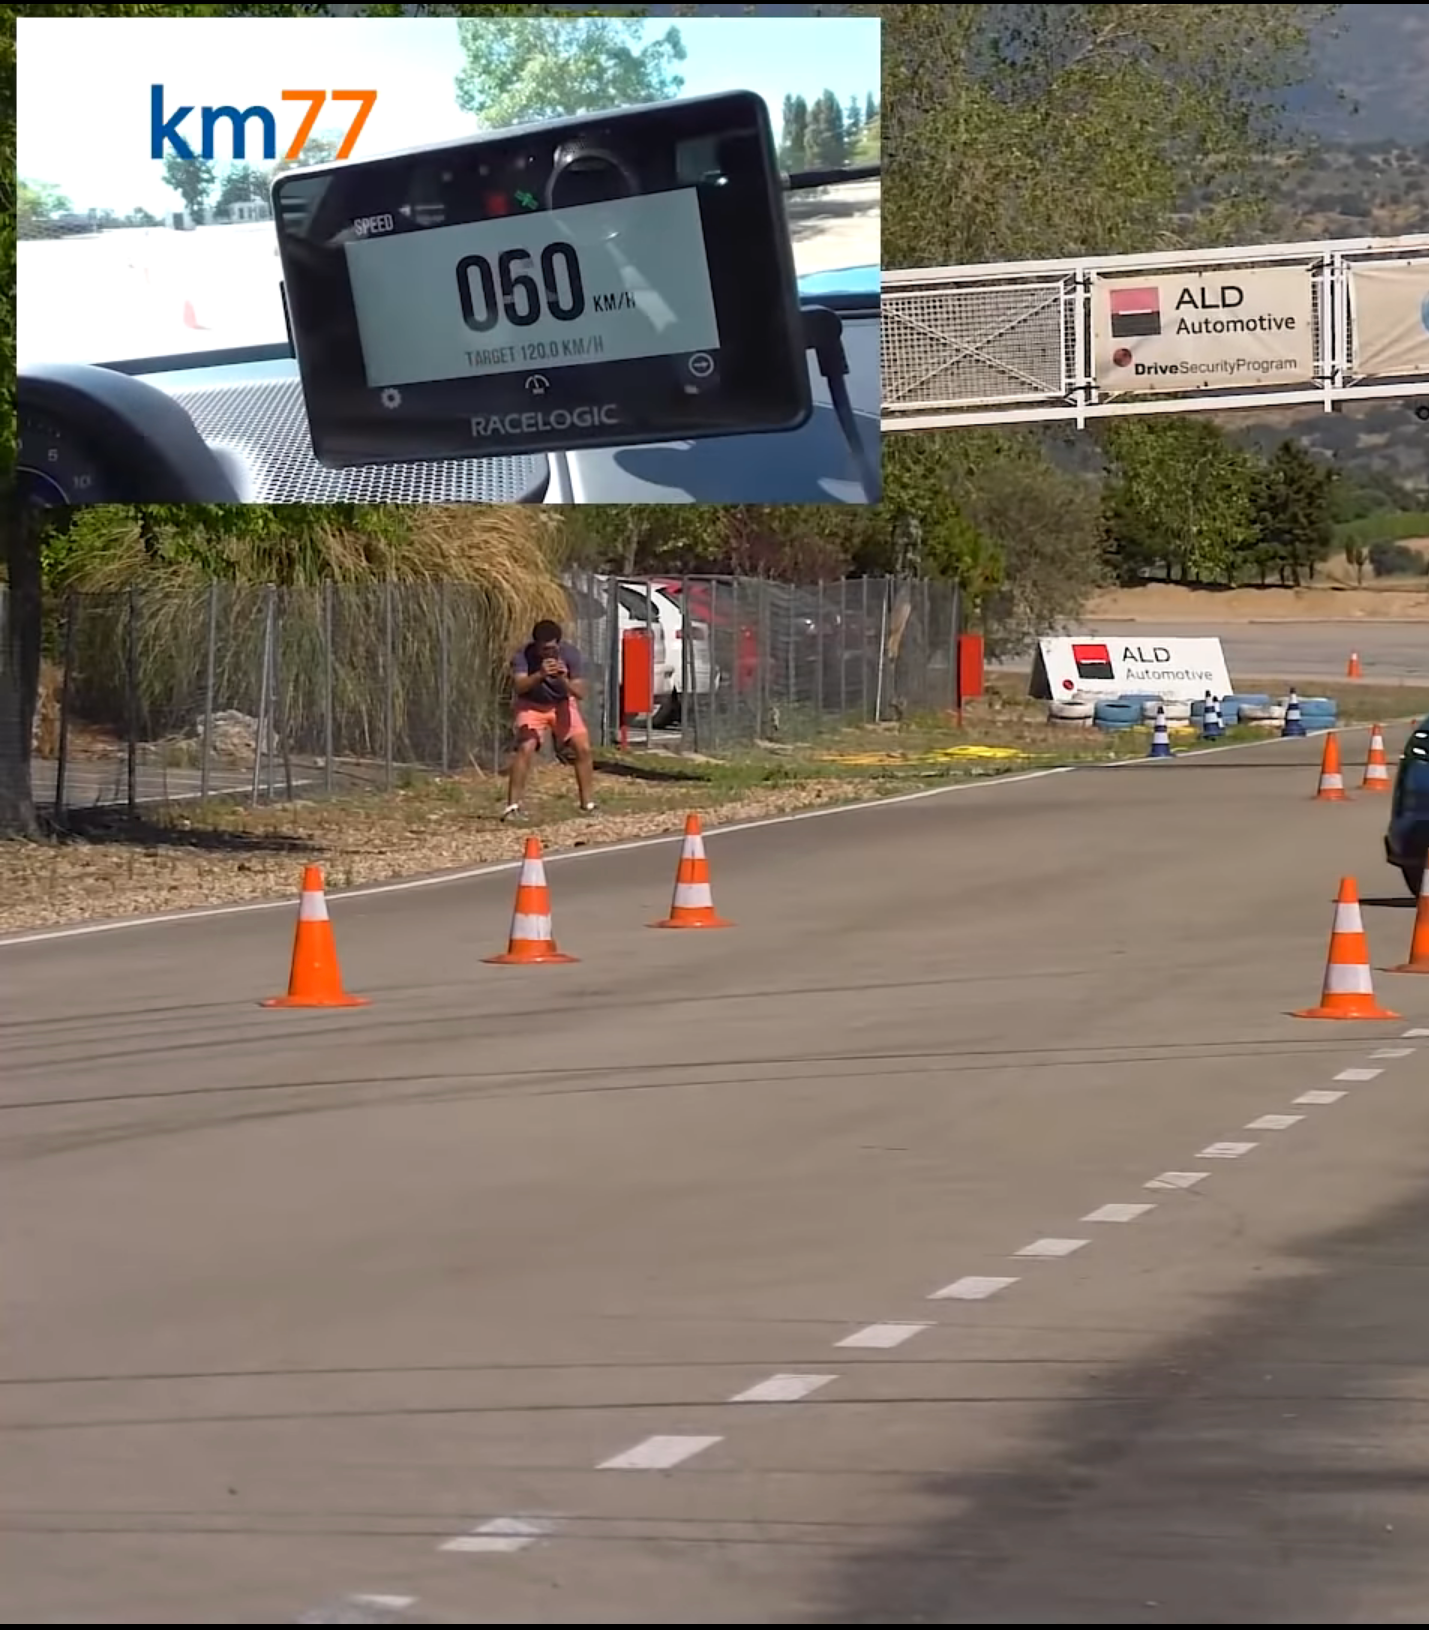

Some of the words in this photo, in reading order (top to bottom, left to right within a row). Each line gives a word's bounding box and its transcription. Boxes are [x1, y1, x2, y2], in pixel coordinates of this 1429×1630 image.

[353, 213, 394, 237] SPEED
[592, 291, 637, 313] KM/H
[1175, 285, 1244, 311] ALD
[1176, 313, 1297, 335] Automotive
[465, 344, 517, 368] TARGET
[520, 339, 559, 362] 120.0
[562, 335, 605, 358] KM/H
[470, 404, 619, 437] RACELOGIC
[1122, 646, 1171, 663] ALD
[1126, 667, 1213, 681] Automotive
